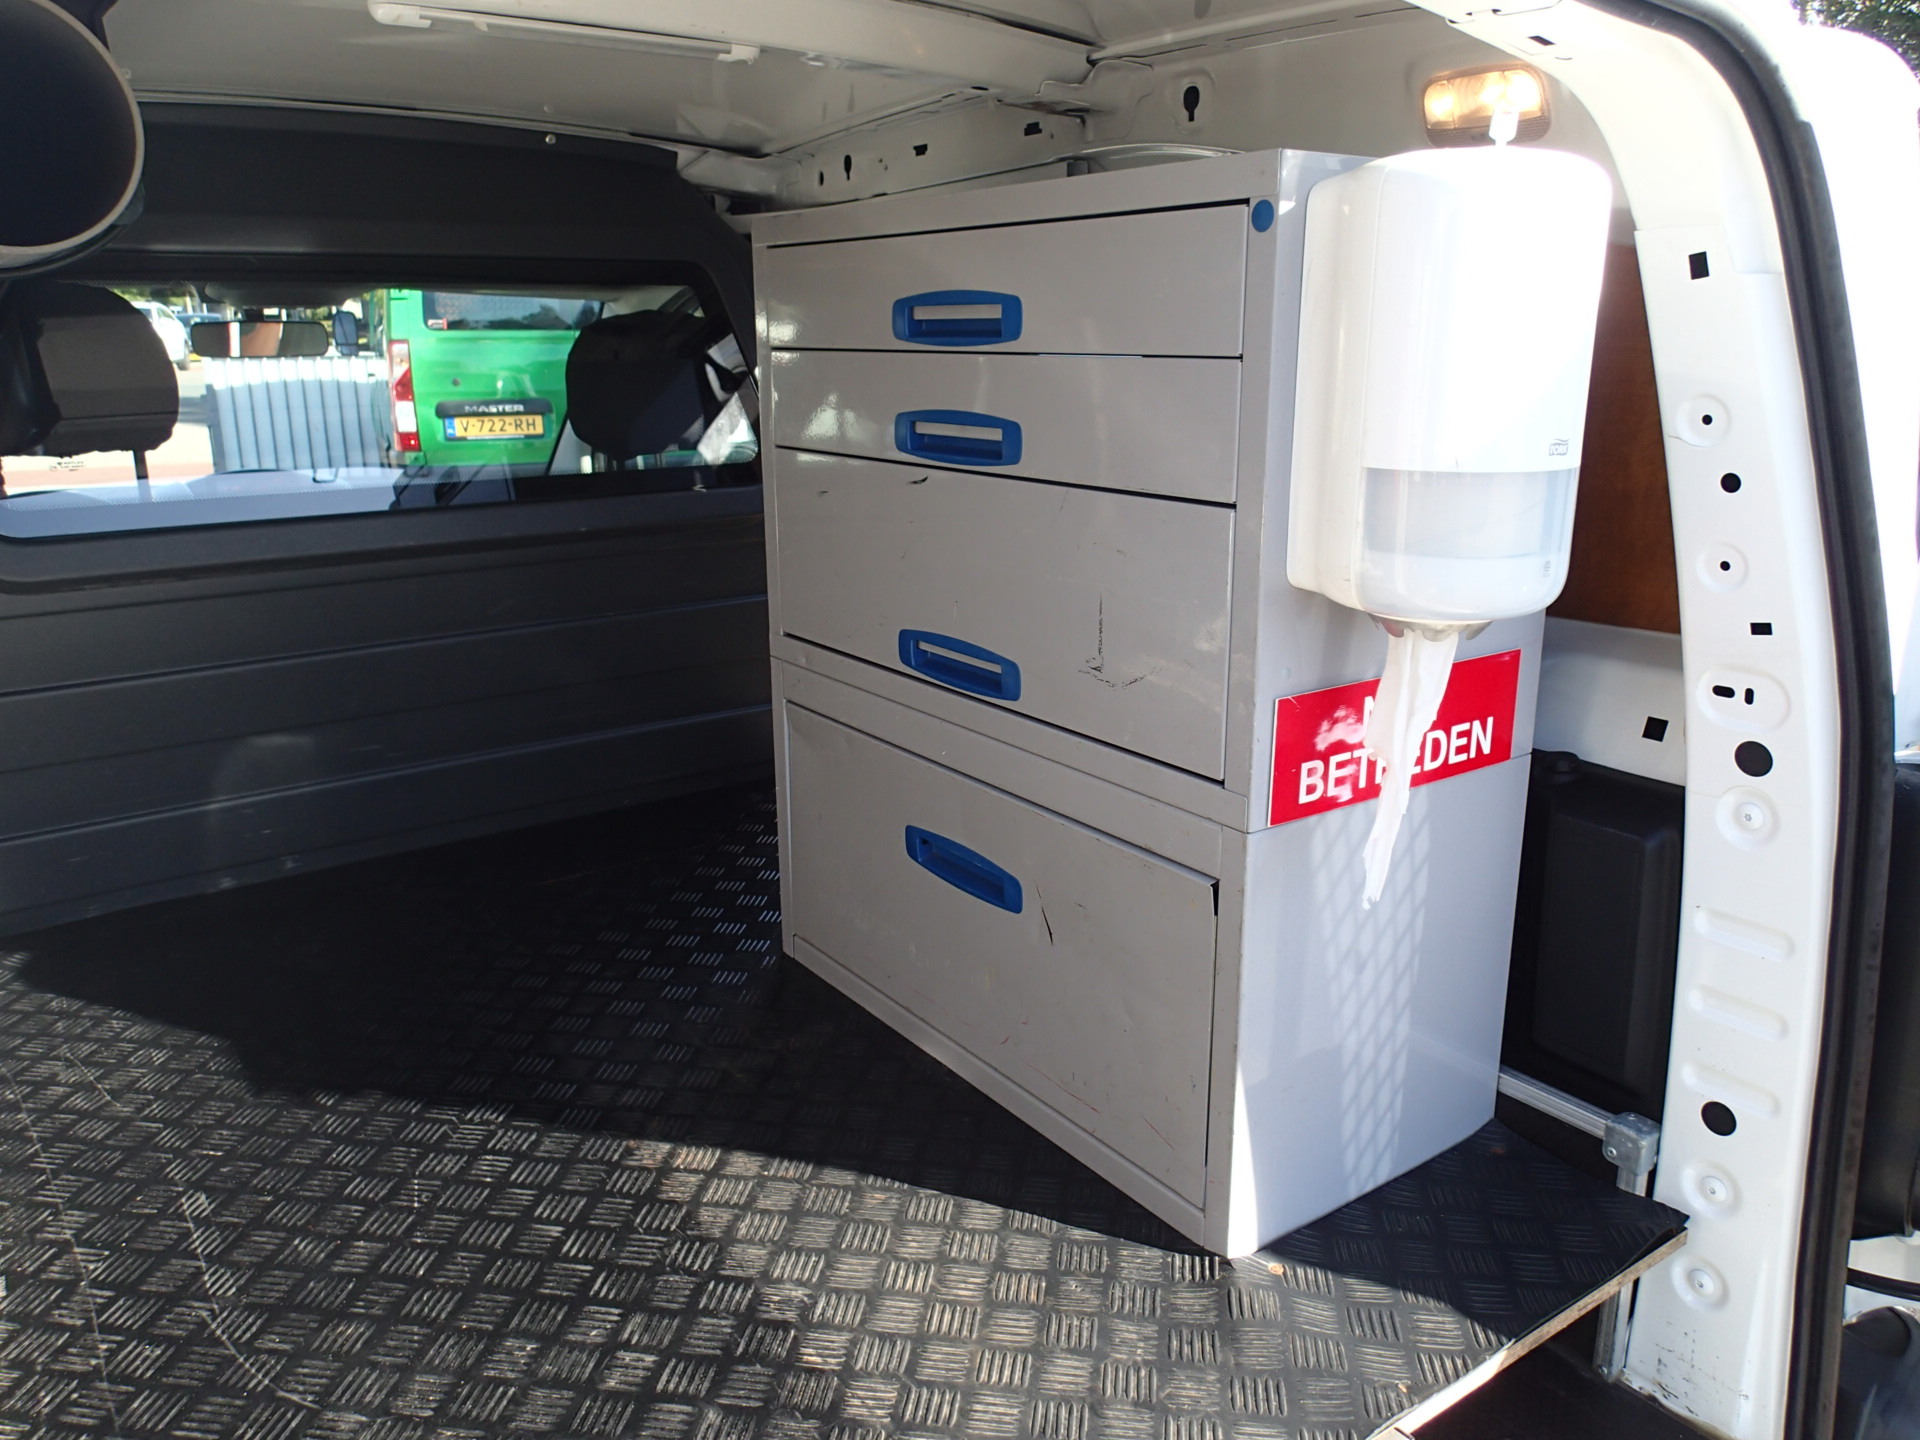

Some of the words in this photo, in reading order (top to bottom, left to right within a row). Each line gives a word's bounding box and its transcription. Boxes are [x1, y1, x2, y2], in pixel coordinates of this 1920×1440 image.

[464, 404, 524, 413] MASTER
[460, 418, 536, 433] V-722-RH
[1298, 716, 1494, 805] BETDEN
